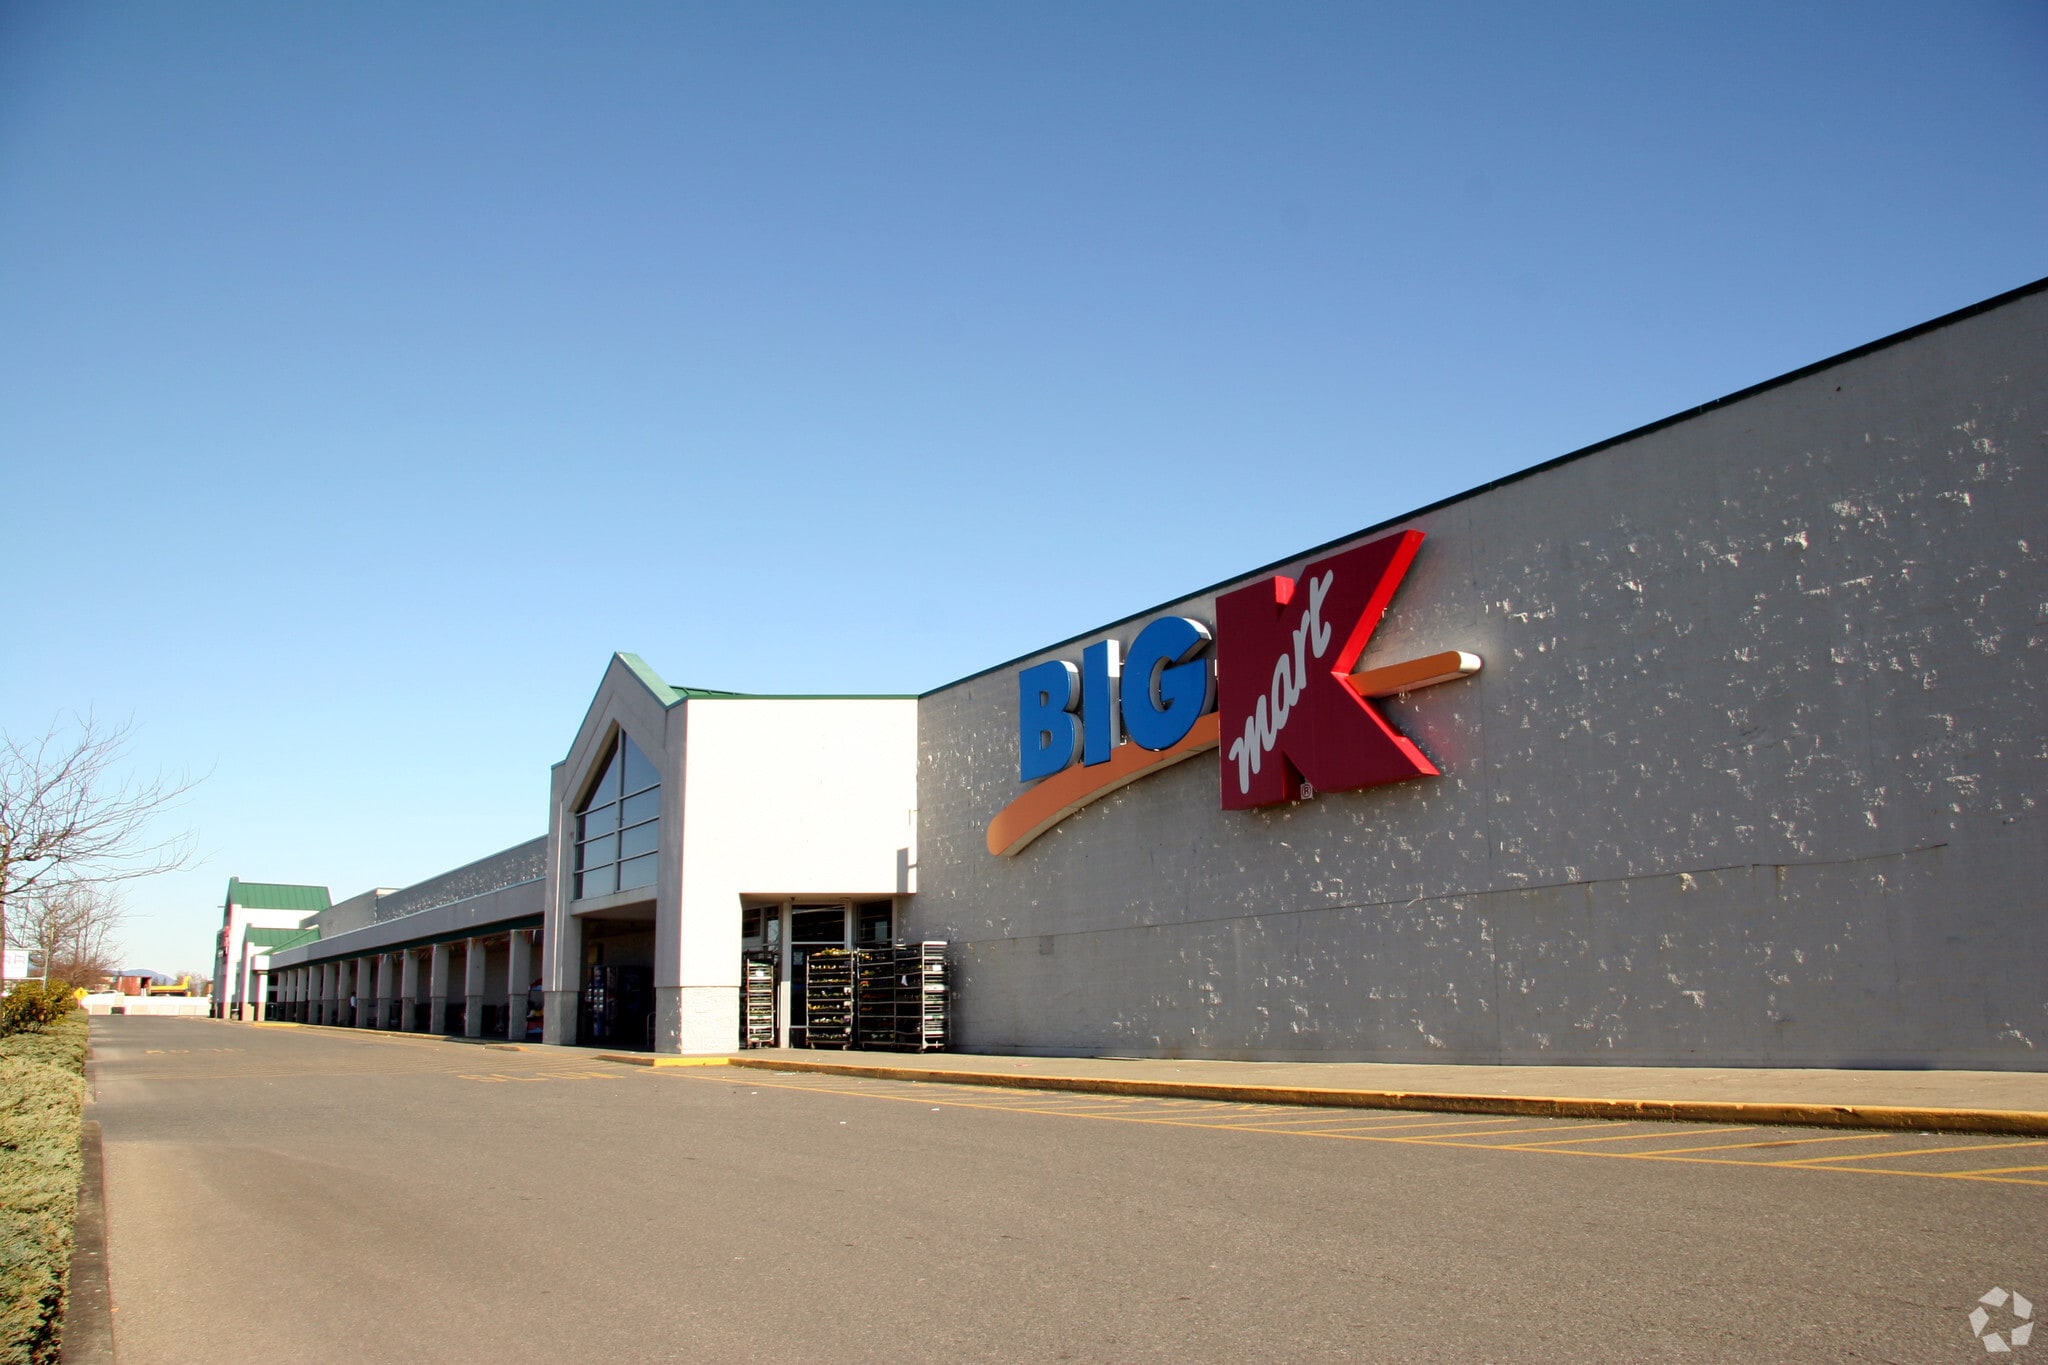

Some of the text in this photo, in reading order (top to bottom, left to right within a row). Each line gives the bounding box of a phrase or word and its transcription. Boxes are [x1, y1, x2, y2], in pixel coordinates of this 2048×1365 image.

[1019, 529, 1439, 811] BIG K
[1228, 569, 1333, 794] mart
